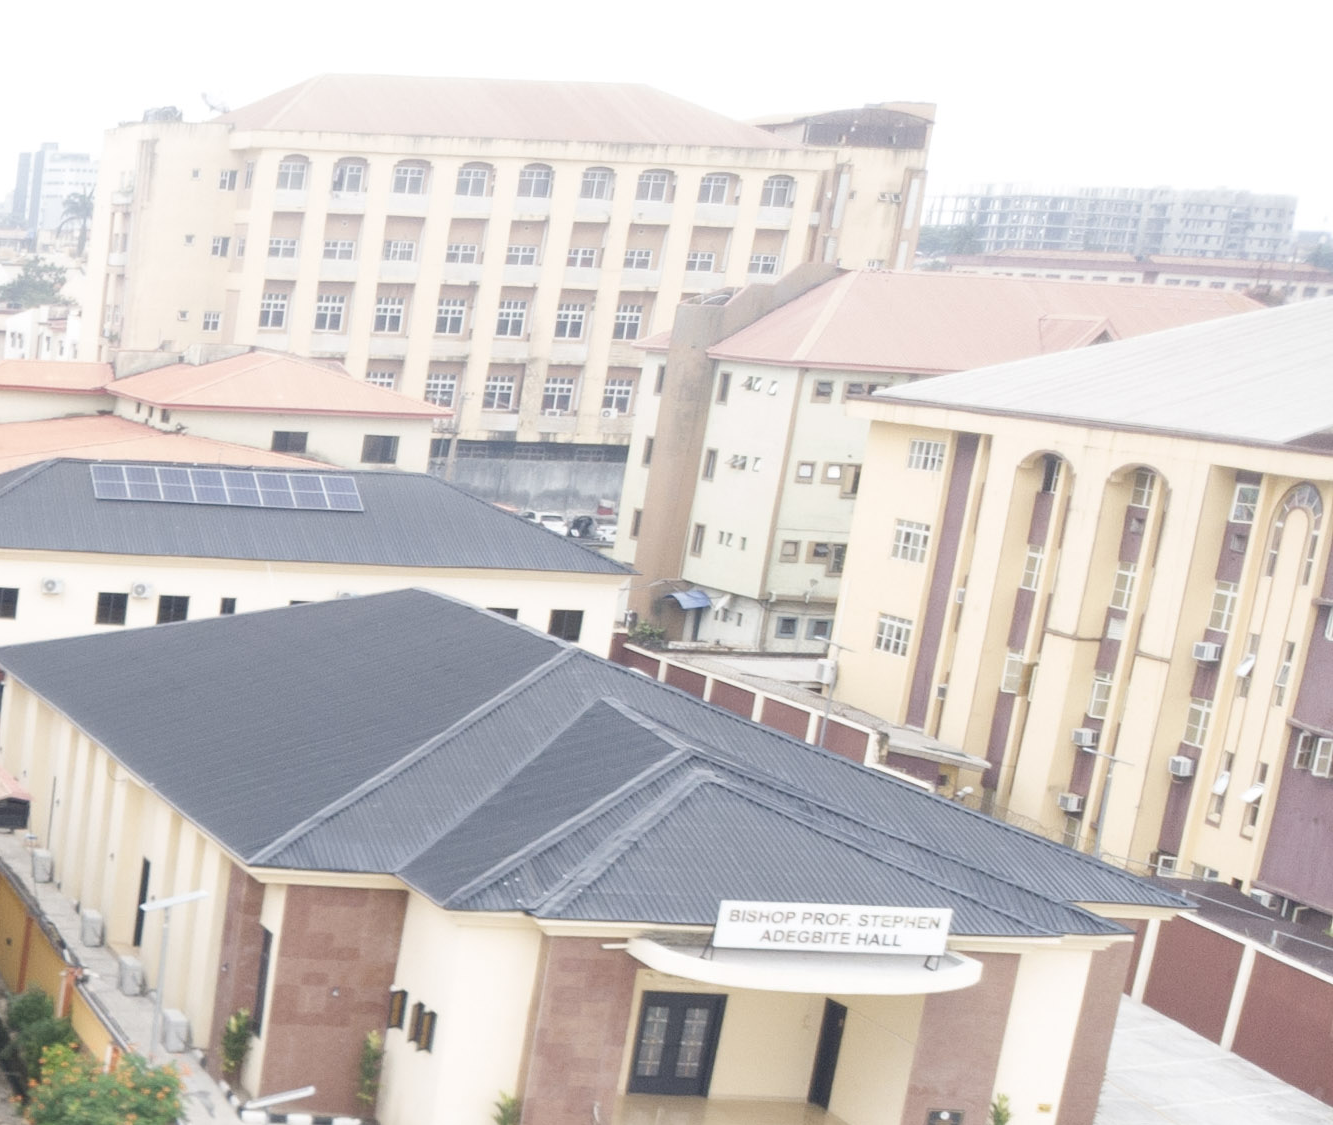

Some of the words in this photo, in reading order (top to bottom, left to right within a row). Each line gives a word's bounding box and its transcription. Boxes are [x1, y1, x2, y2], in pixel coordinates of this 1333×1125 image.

[729, 908, 796, 924] BISHOP
[800, 911, 852, 927] PROF.
[857, 914, 942, 930] STEPHEN
[758, 929, 852, 945] ADEGBITE
[855, 933, 902, 948] HALL
